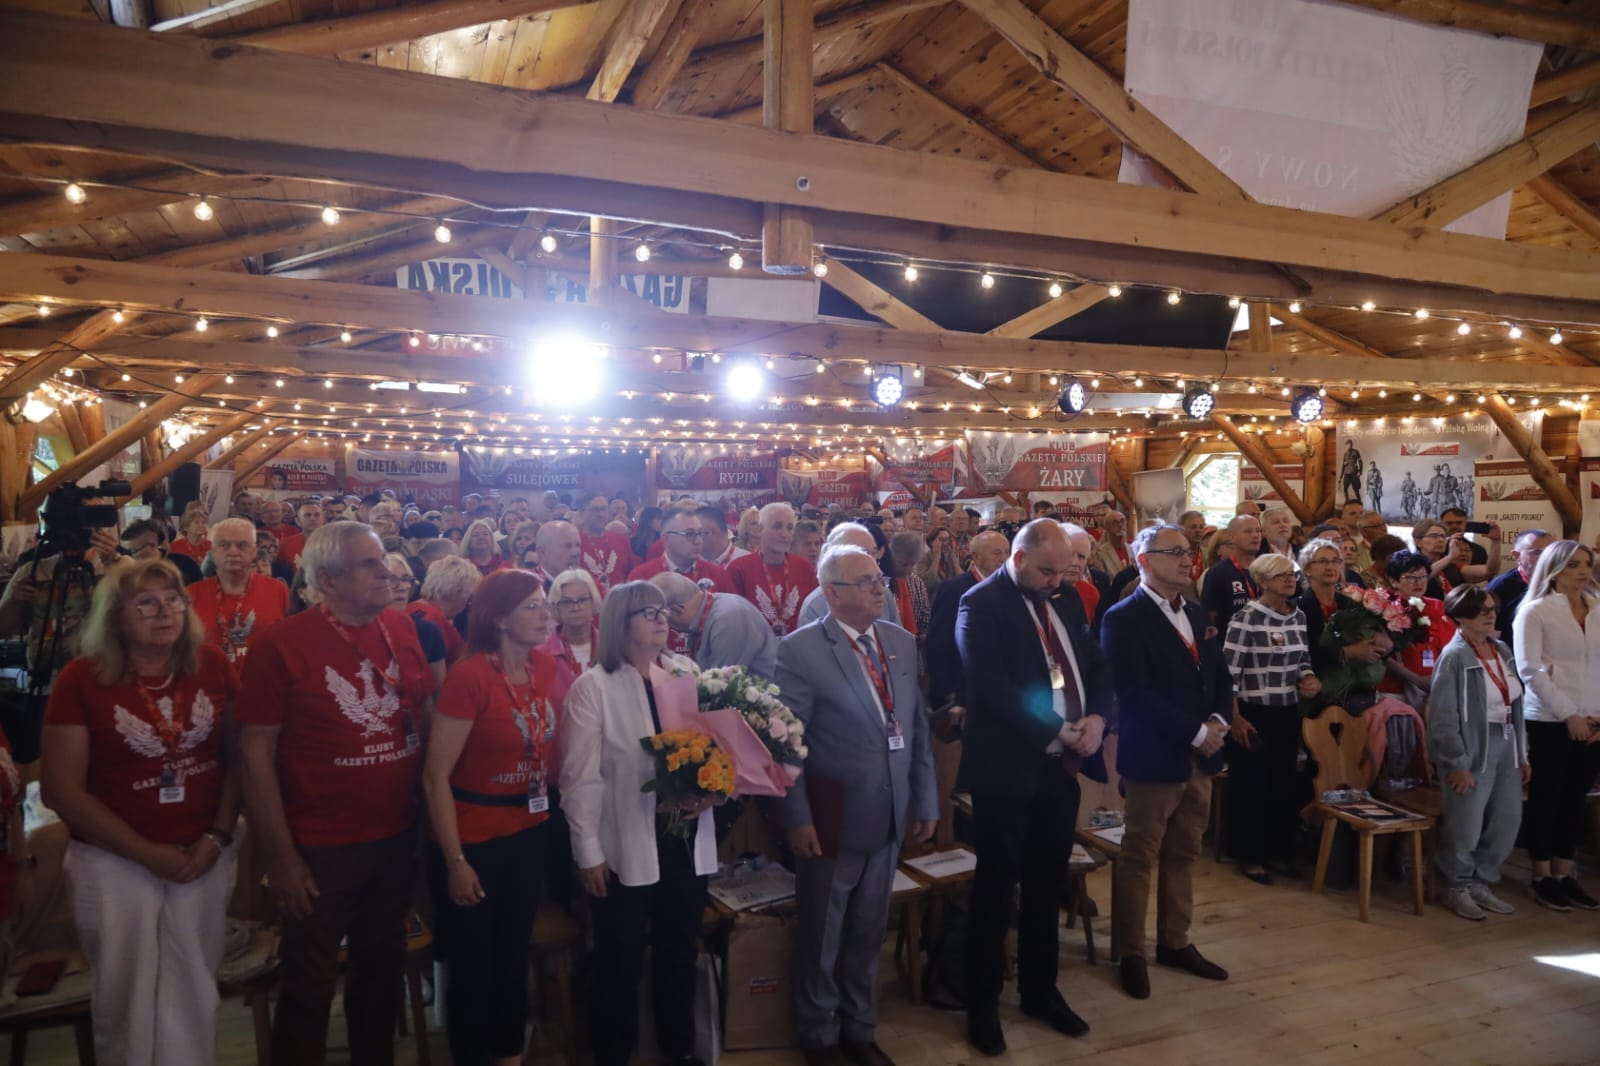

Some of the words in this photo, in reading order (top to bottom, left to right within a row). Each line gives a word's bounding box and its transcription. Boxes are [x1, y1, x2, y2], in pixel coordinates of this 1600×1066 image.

[1049, 441, 1075, 452] KLUB
[1018, 453, 1058, 464] GAZETY
[1061, 452, 1107, 465] POLSKIEJ
[357, 459, 397, 473] GAZETA
[409, 461, 448, 474] POLSKA
[506, 471, 579, 487] SULEJÓWEK
[719, 472, 759, 485] RYPIN
[1040, 466, 1086, 487] ŻARY
[818, 483, 852, 494] GAZETY
[364, 741, 395, 755] KLUBY
[334, 756, 377, 767] GAZETY
